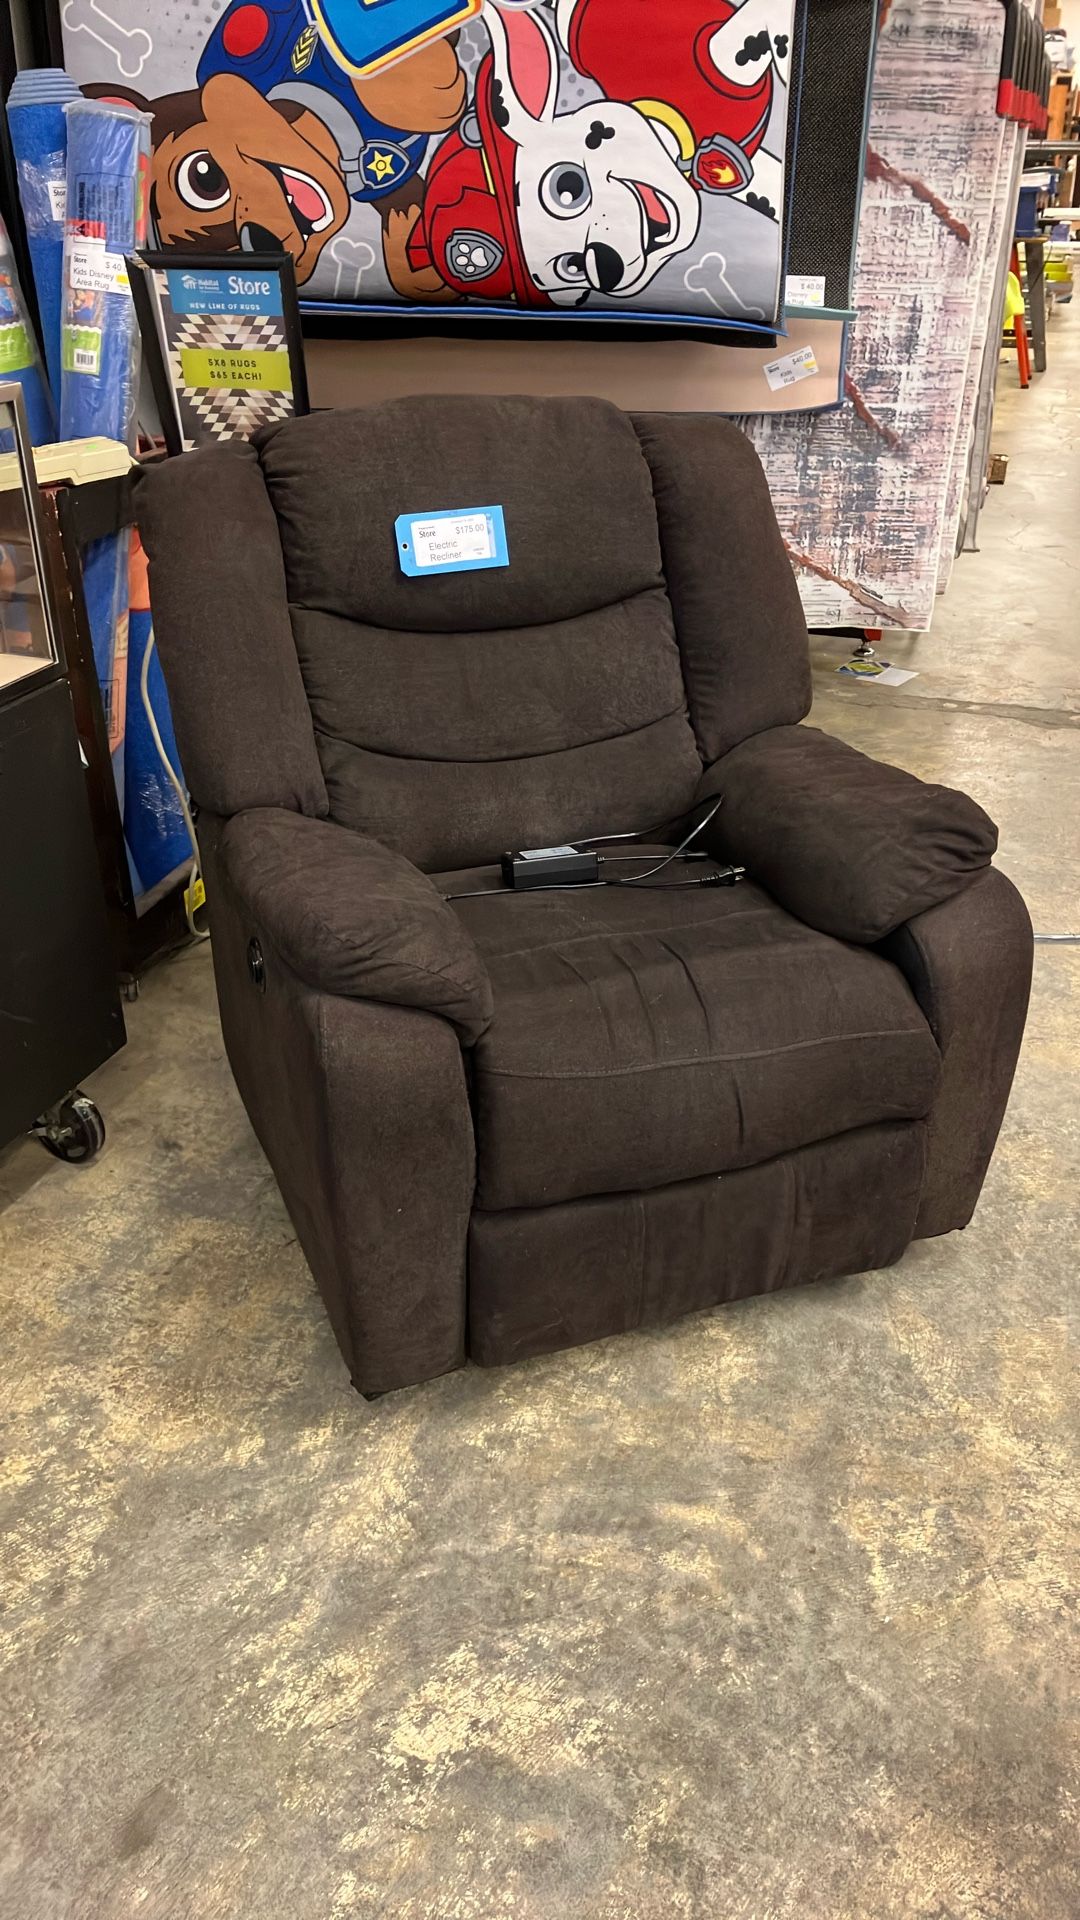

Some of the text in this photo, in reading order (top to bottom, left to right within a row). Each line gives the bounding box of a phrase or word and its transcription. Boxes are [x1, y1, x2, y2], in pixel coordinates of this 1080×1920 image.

[73, 267, 114, 282] Kids Disney
[76, 278, 92, 287] Area
[94, 280, 110, 290] Rug
[228, 276, 270, 295] Store
[208, 358, 257, 368] 5X8 RUGS
[210, 370, 262, 381] $65 EACH!
[419, 530, 436, 538] Store
[455, 523, 485, 535] $175.00
[428, 540, 458, 551] Electric
[430, 551, 462, 562] Recliner
